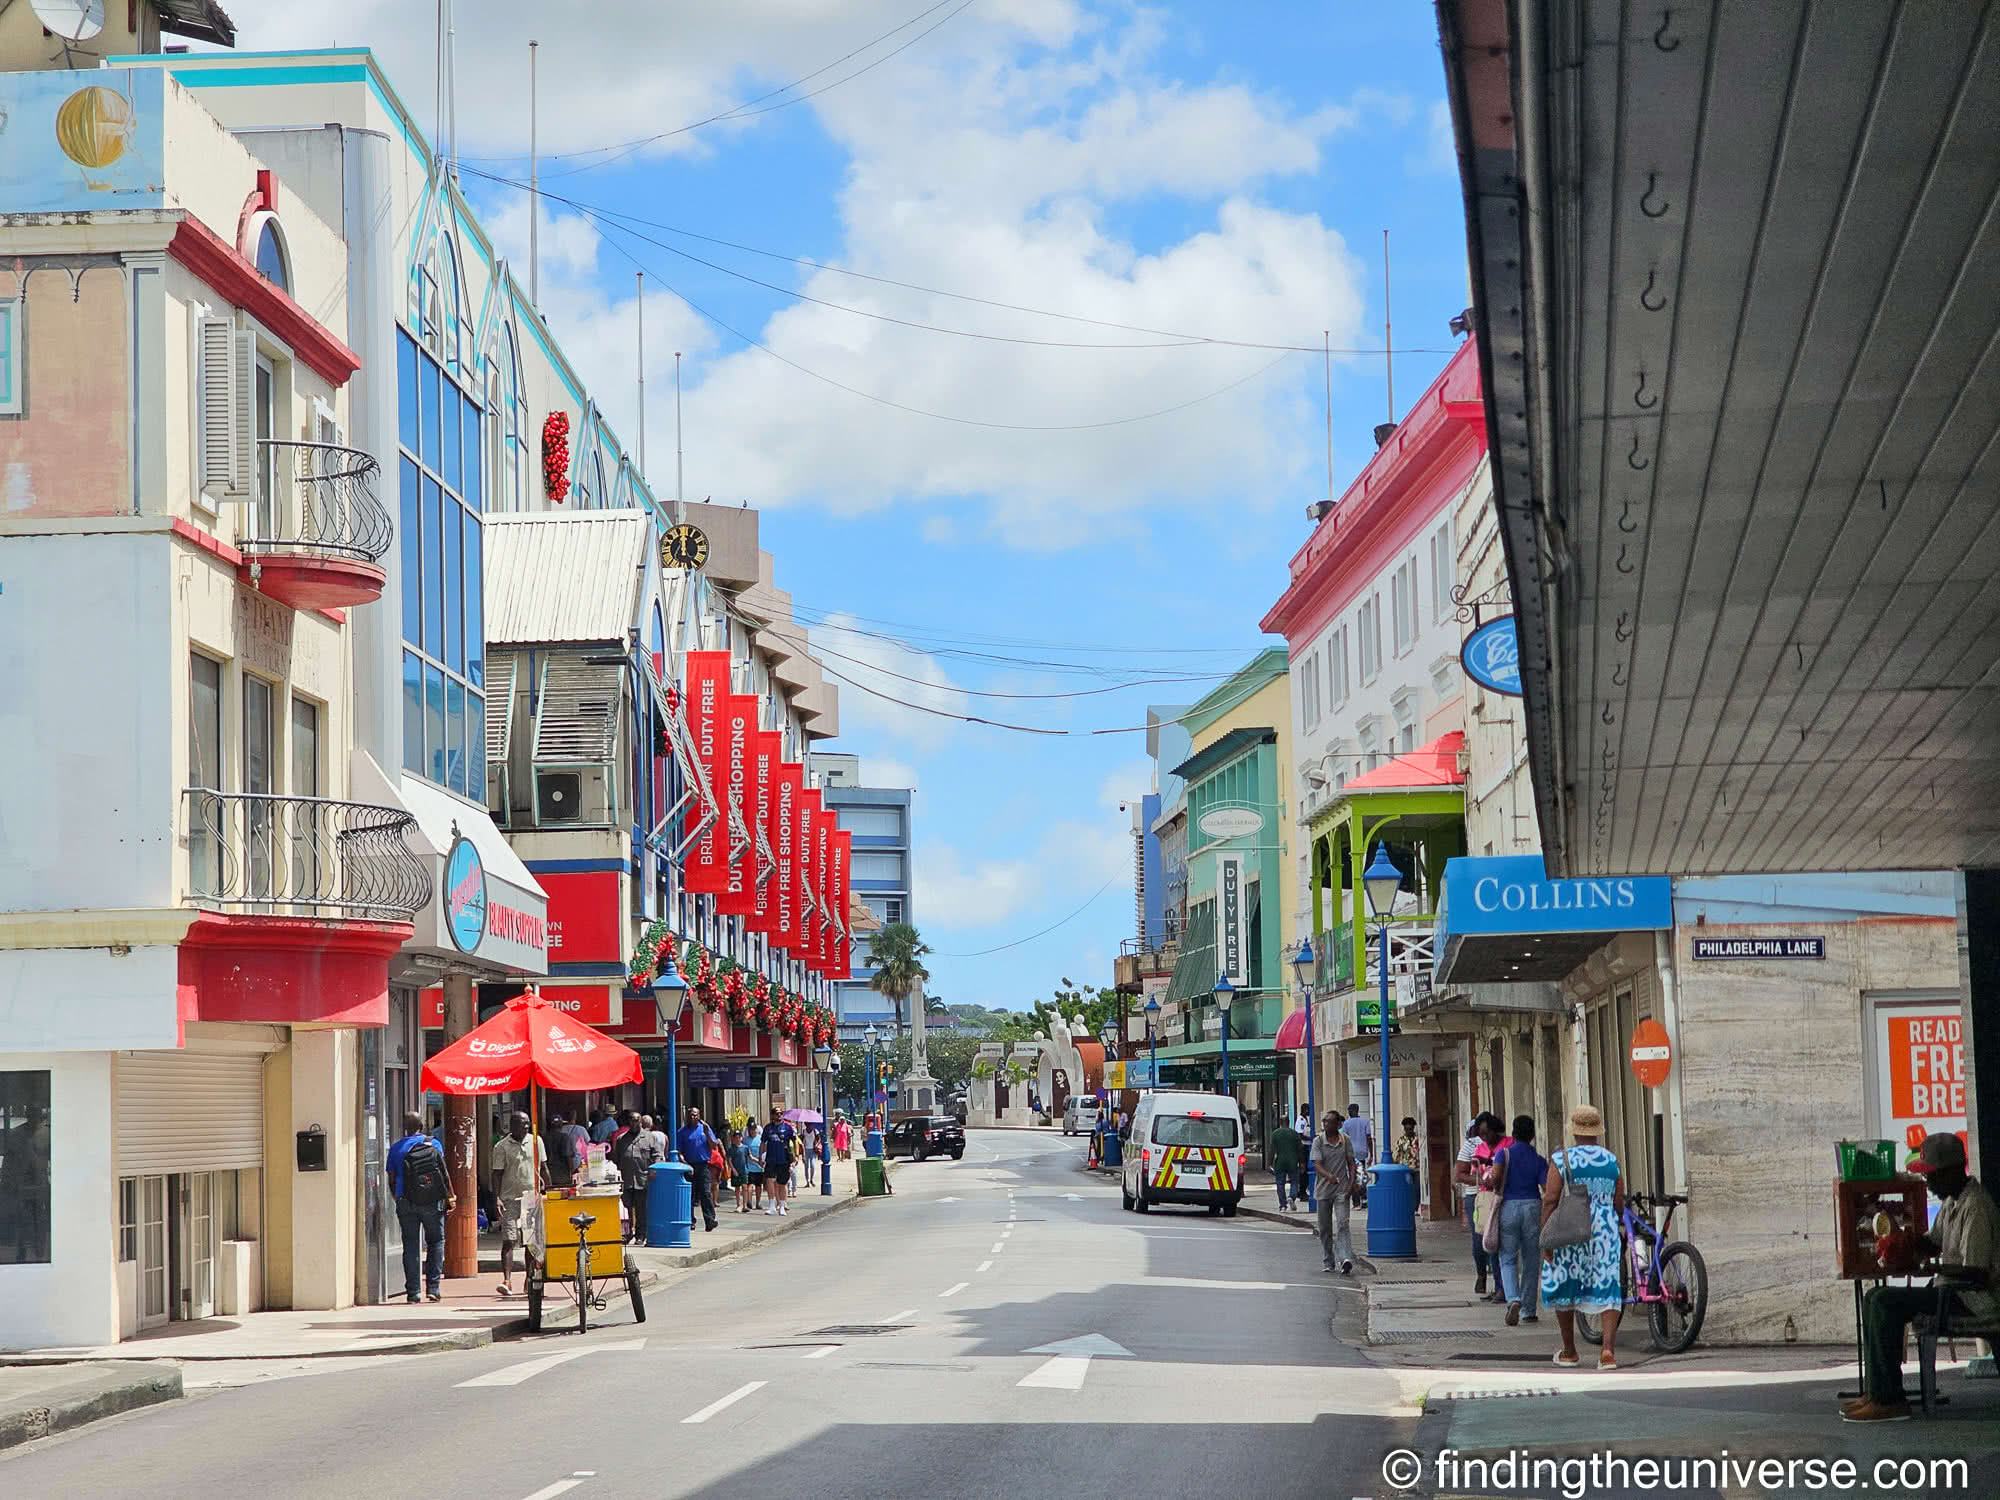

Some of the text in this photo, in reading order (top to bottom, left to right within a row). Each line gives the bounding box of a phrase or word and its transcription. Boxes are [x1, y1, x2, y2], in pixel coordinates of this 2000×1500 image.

[702, 679, 715, 714] FREE
[701, 716, 714, 756] DUTY
[731, 717, 745, 805] SHOPPING
[758, 754, 769, 784] FREE
[758, 785, 769, 819] DUTY
[801, 808, 810, 833] FREE
[780, 781, 792, 929] DUTY FREE SHOPPING
[801, 835, 810, 863] DUTY
[1474, 877, 1635, 912] COLLINS
[489, 901, 515, 942] BEAUTY
[1226, 868, 1237, 970] DUTY FREE
[1699, 941, 1817, 955] PHILADELPHIA LANE
[1909, 1019, 1962, 1043] READ
[1365, 1052, 1416, 1063] ROANA
[444, 1075, 512, 1090] TOP UP TODAY
